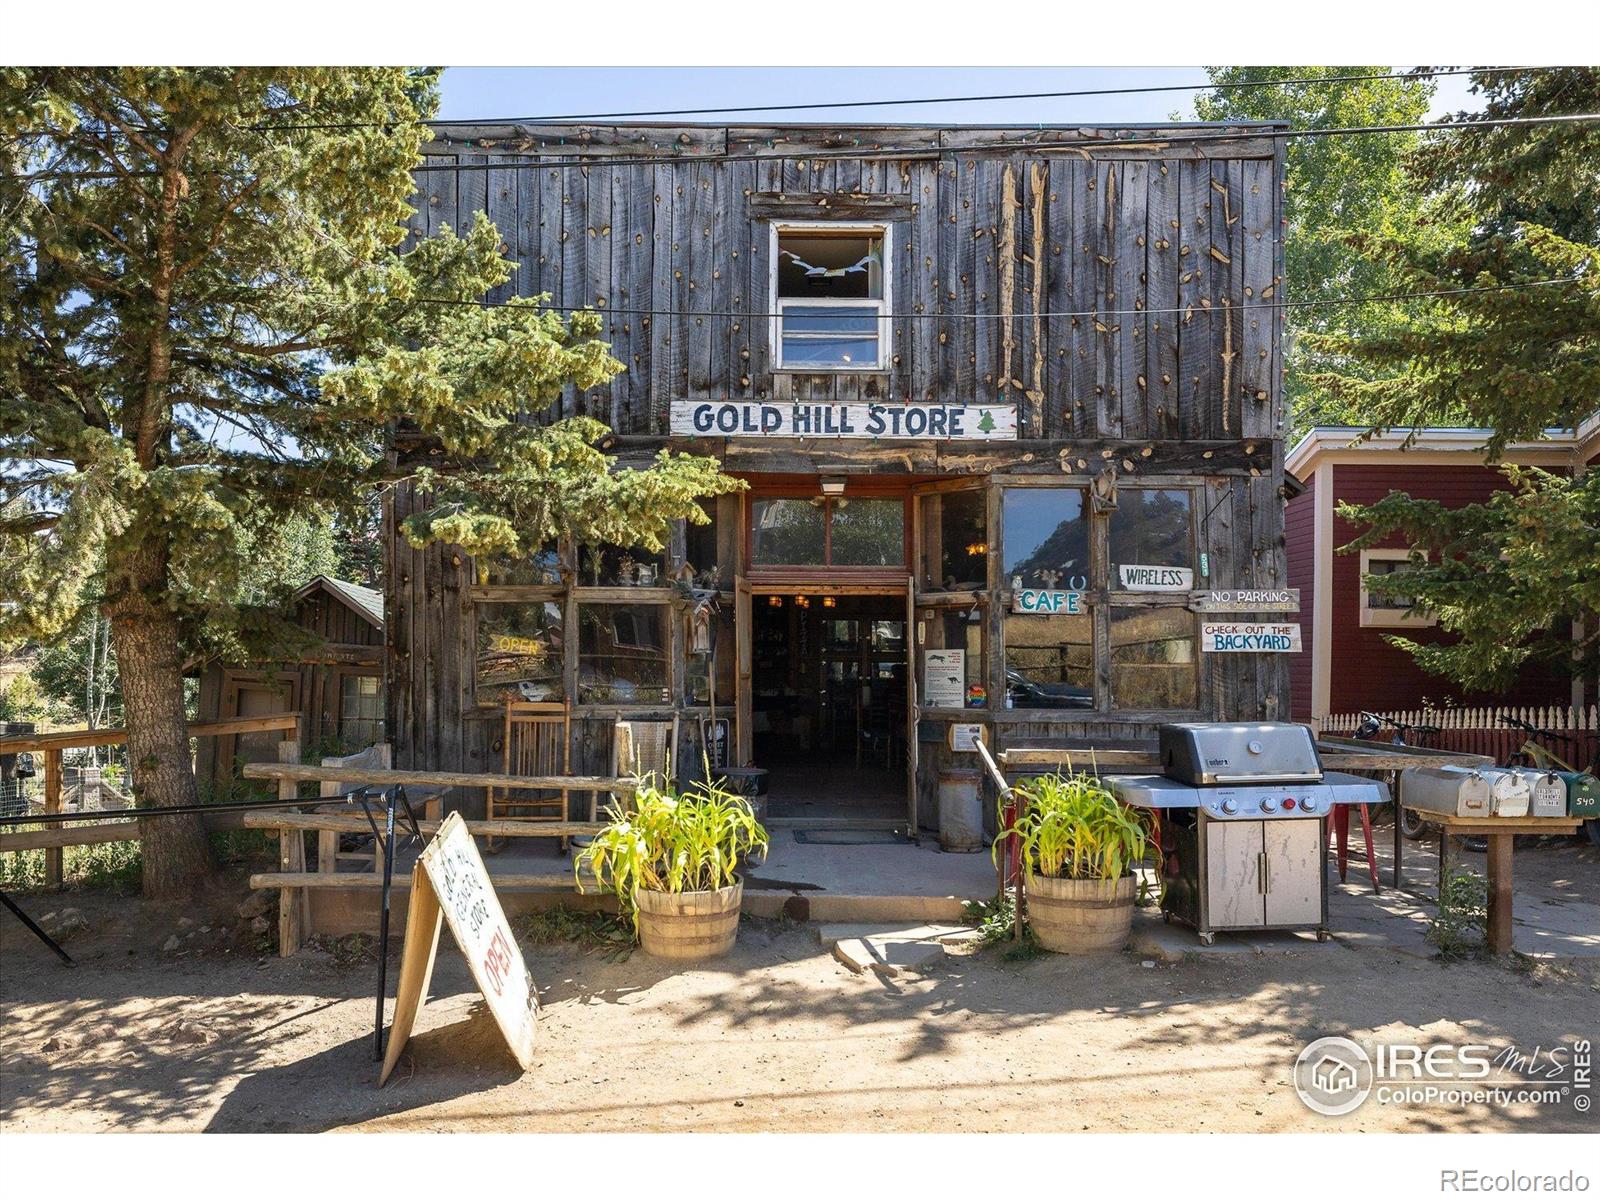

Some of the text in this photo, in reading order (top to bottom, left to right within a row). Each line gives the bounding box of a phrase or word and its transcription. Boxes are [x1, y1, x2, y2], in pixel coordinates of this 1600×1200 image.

[693, 403, 965, 436] GOLD HILL STORE
[1125, 567, 1184, 587] WIRELESS
[1019, 590, 1080, 613] CAFE
[1211, 591, 1290, 603] NO PARKING
[1205, 625, 1291, 635] CHECK OUT THE
[499, 637, 539, 655] OPEN
[1213, 634, 1291, 650] BACKYARD
[1576, 797, 1595, 806] 540
[470, 899, 490, 939] STORE
[483, 925, 513, 997] OPEN
